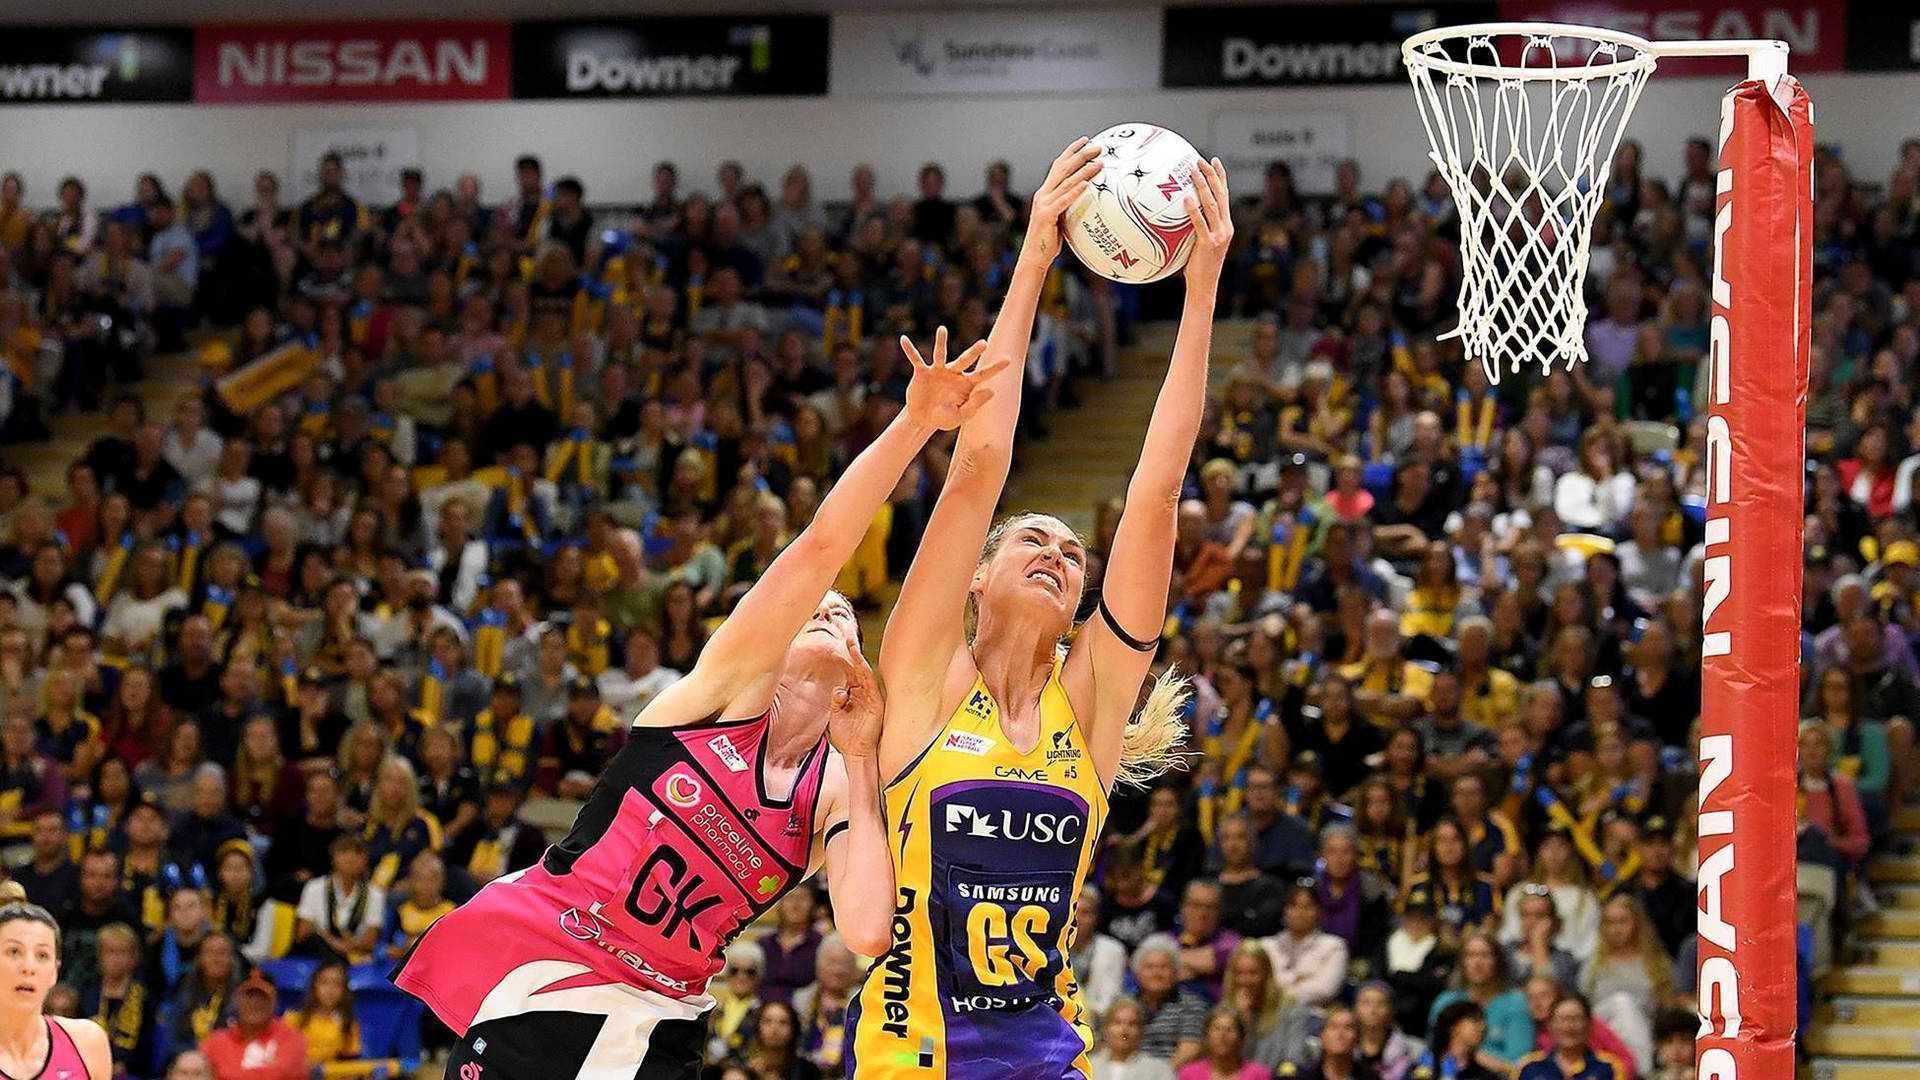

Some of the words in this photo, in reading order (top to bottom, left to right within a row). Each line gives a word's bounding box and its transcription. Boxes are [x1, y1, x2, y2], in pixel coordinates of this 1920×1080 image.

[217, 40, 489, 87] NISSAN
[566, 48, 740, 92] Downer
[1222, 37, 1402, 79] Downer
[1094, 212, 1122, 249] NETBALL
[1094, 227, 1117, 252] SUPER
[1046, 749, 1081, 759] LIGHTNING
[1064, 766, 1077, 779] #5
[690, 814, 751, 880] pharmacy
[701, 803, 763, 869] priceline
[1001, 809, 1080, 845] USC
[625, 844, 724, 952] GK
[957, 883, 1060, 903] SAMSUNG
[882, 886, 917, 1038] Downer
[967, 902, 1050, 987] GS
